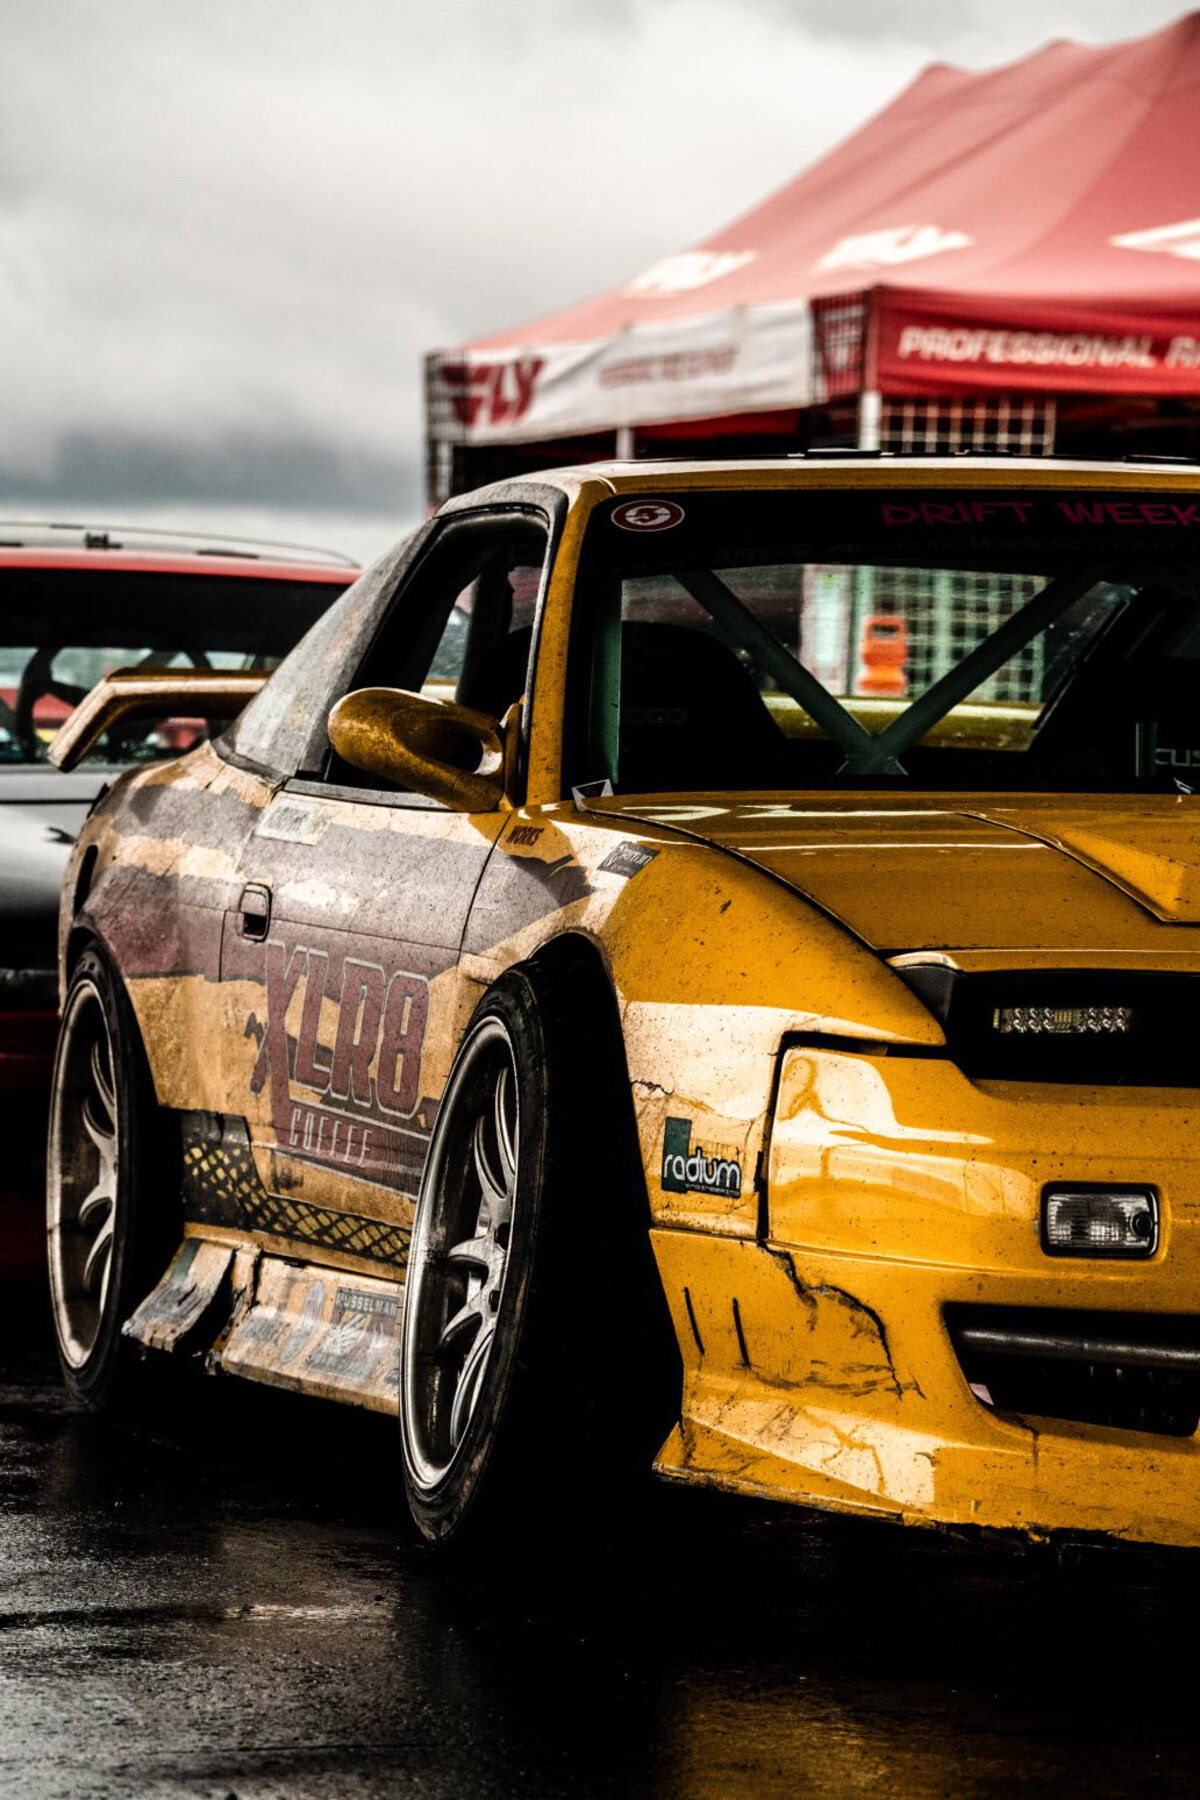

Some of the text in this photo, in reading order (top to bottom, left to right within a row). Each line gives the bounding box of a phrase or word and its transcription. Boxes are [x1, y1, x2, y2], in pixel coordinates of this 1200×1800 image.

[898, 327, 1156, 368] PROFESSIONAL
[440, 358, 544, 426] FLY
[880, 502, 1200, 526] DRIFT WEEK
[251, 939, 430, 1125] XLR8
[664, 1149, 741, 1190] radium
